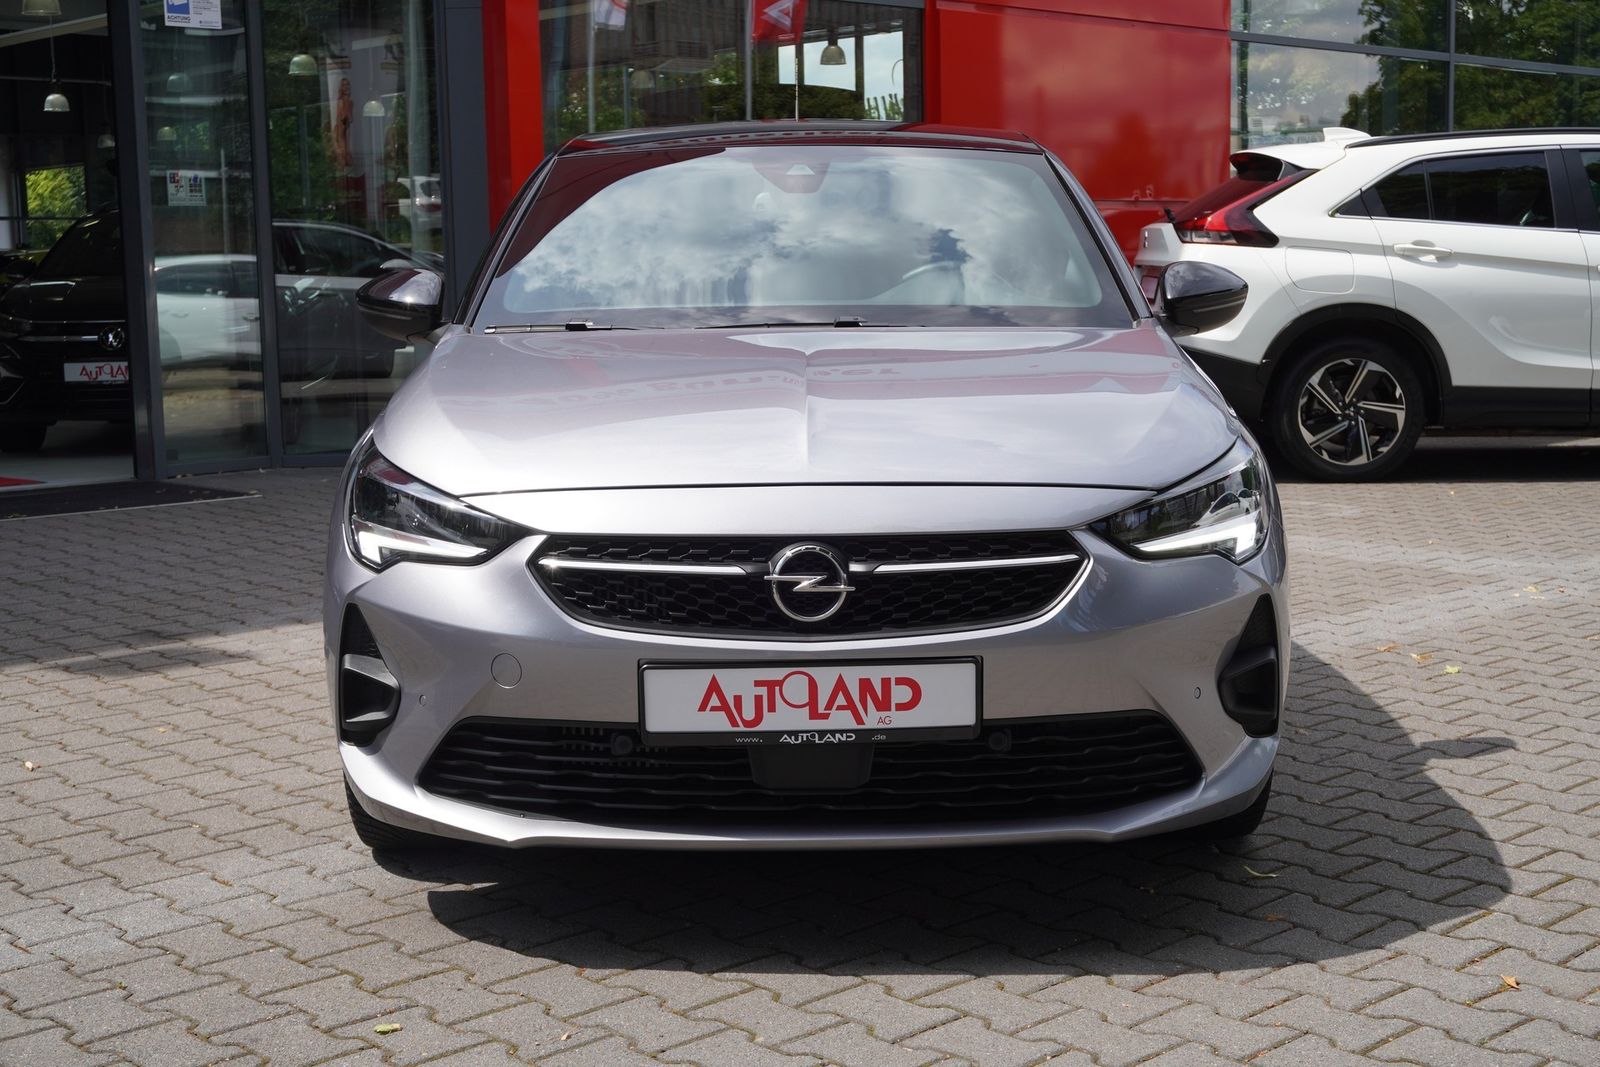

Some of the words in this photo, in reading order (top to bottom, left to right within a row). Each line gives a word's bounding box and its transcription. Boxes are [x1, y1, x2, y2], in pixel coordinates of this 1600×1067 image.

[79, 363, 128, 380] AUTOLA
[697, 670, 922, 728] AUTOLAND
[877, 715, 892, 726] AG
[779, 731, 856, 744] AUTOLAND
[871, 734, 887, 742] .de
